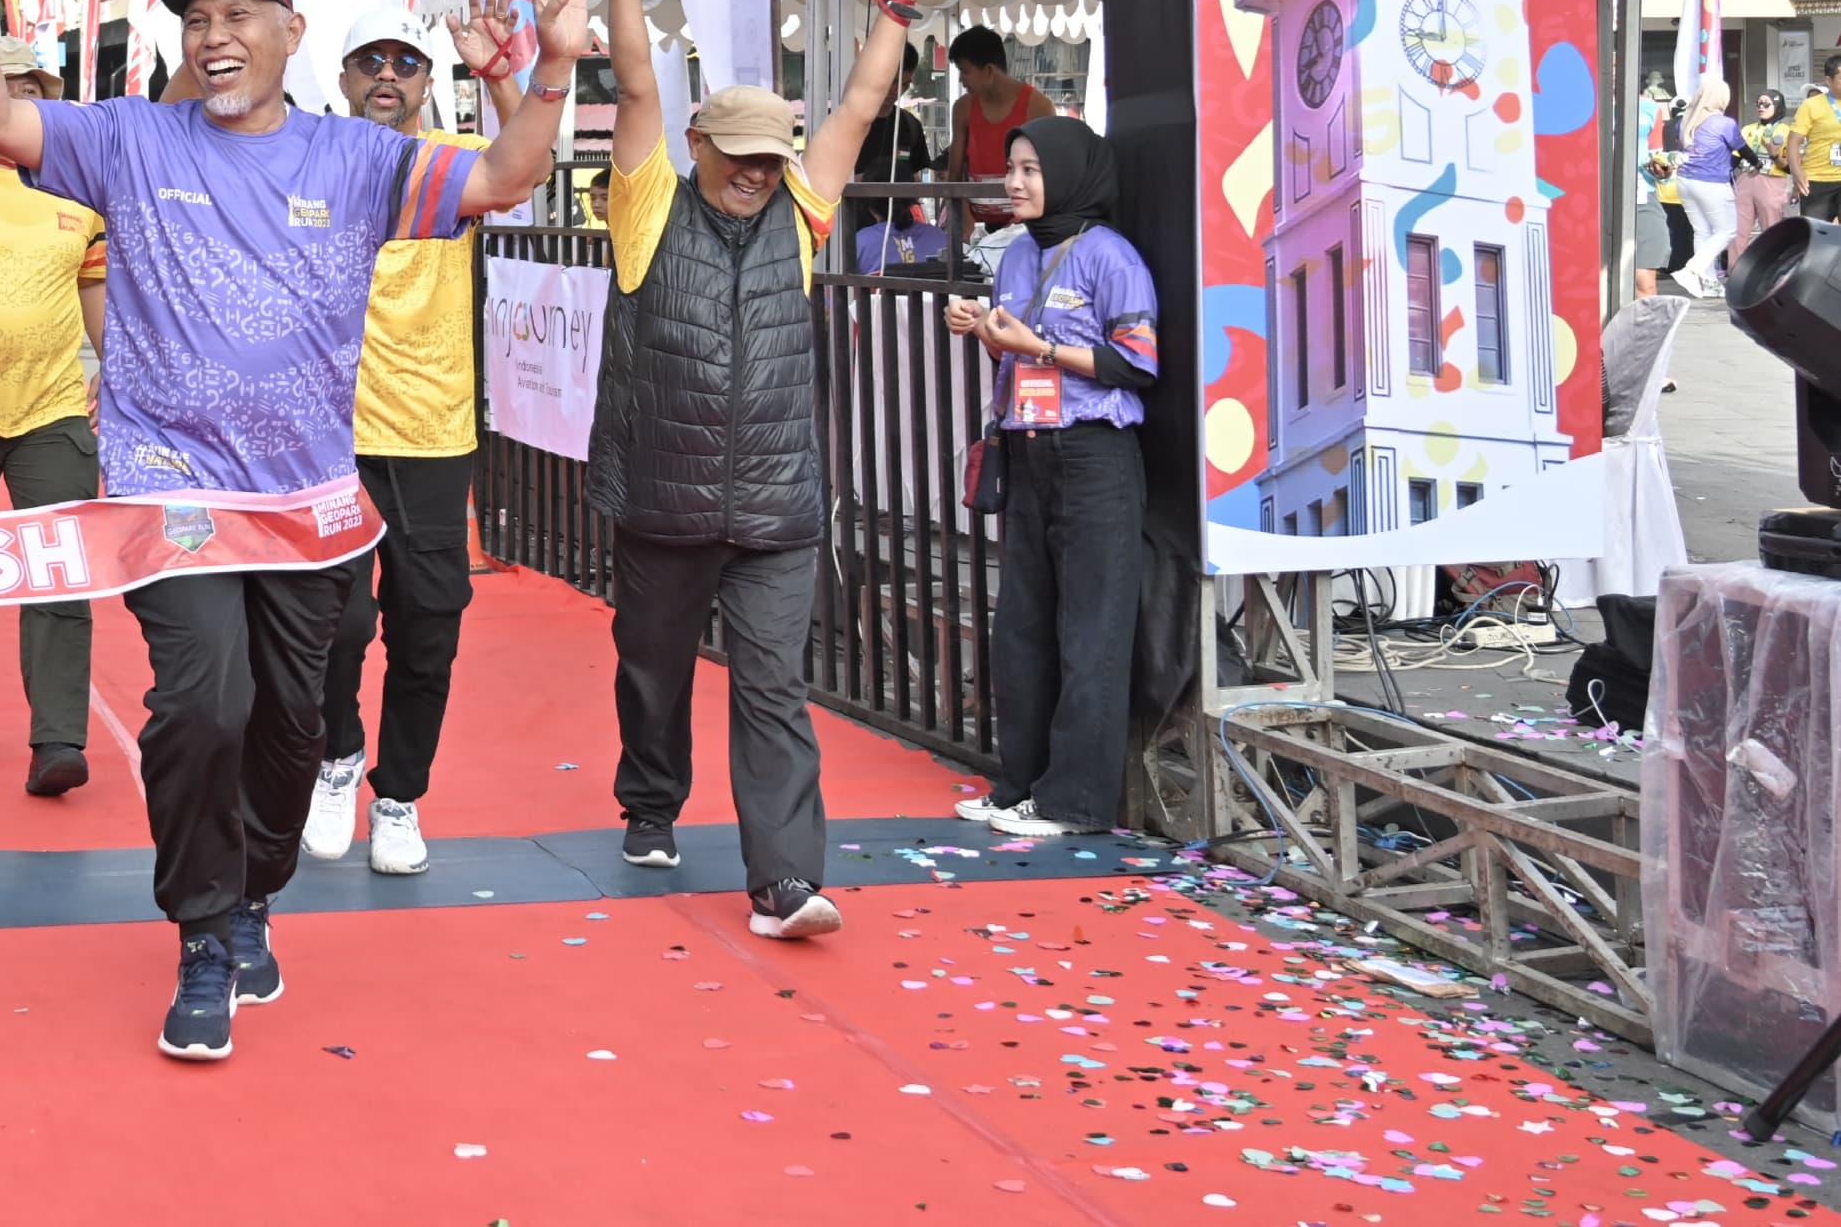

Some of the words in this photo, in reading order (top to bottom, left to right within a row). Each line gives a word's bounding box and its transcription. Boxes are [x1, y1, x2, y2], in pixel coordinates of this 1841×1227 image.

[158, 187, 213, 206] OFFICIAL
[317, 493, 356, 514] MINANG
[323, 523, 342, 538] RUN
[342, 516, 363, 530] 2023
